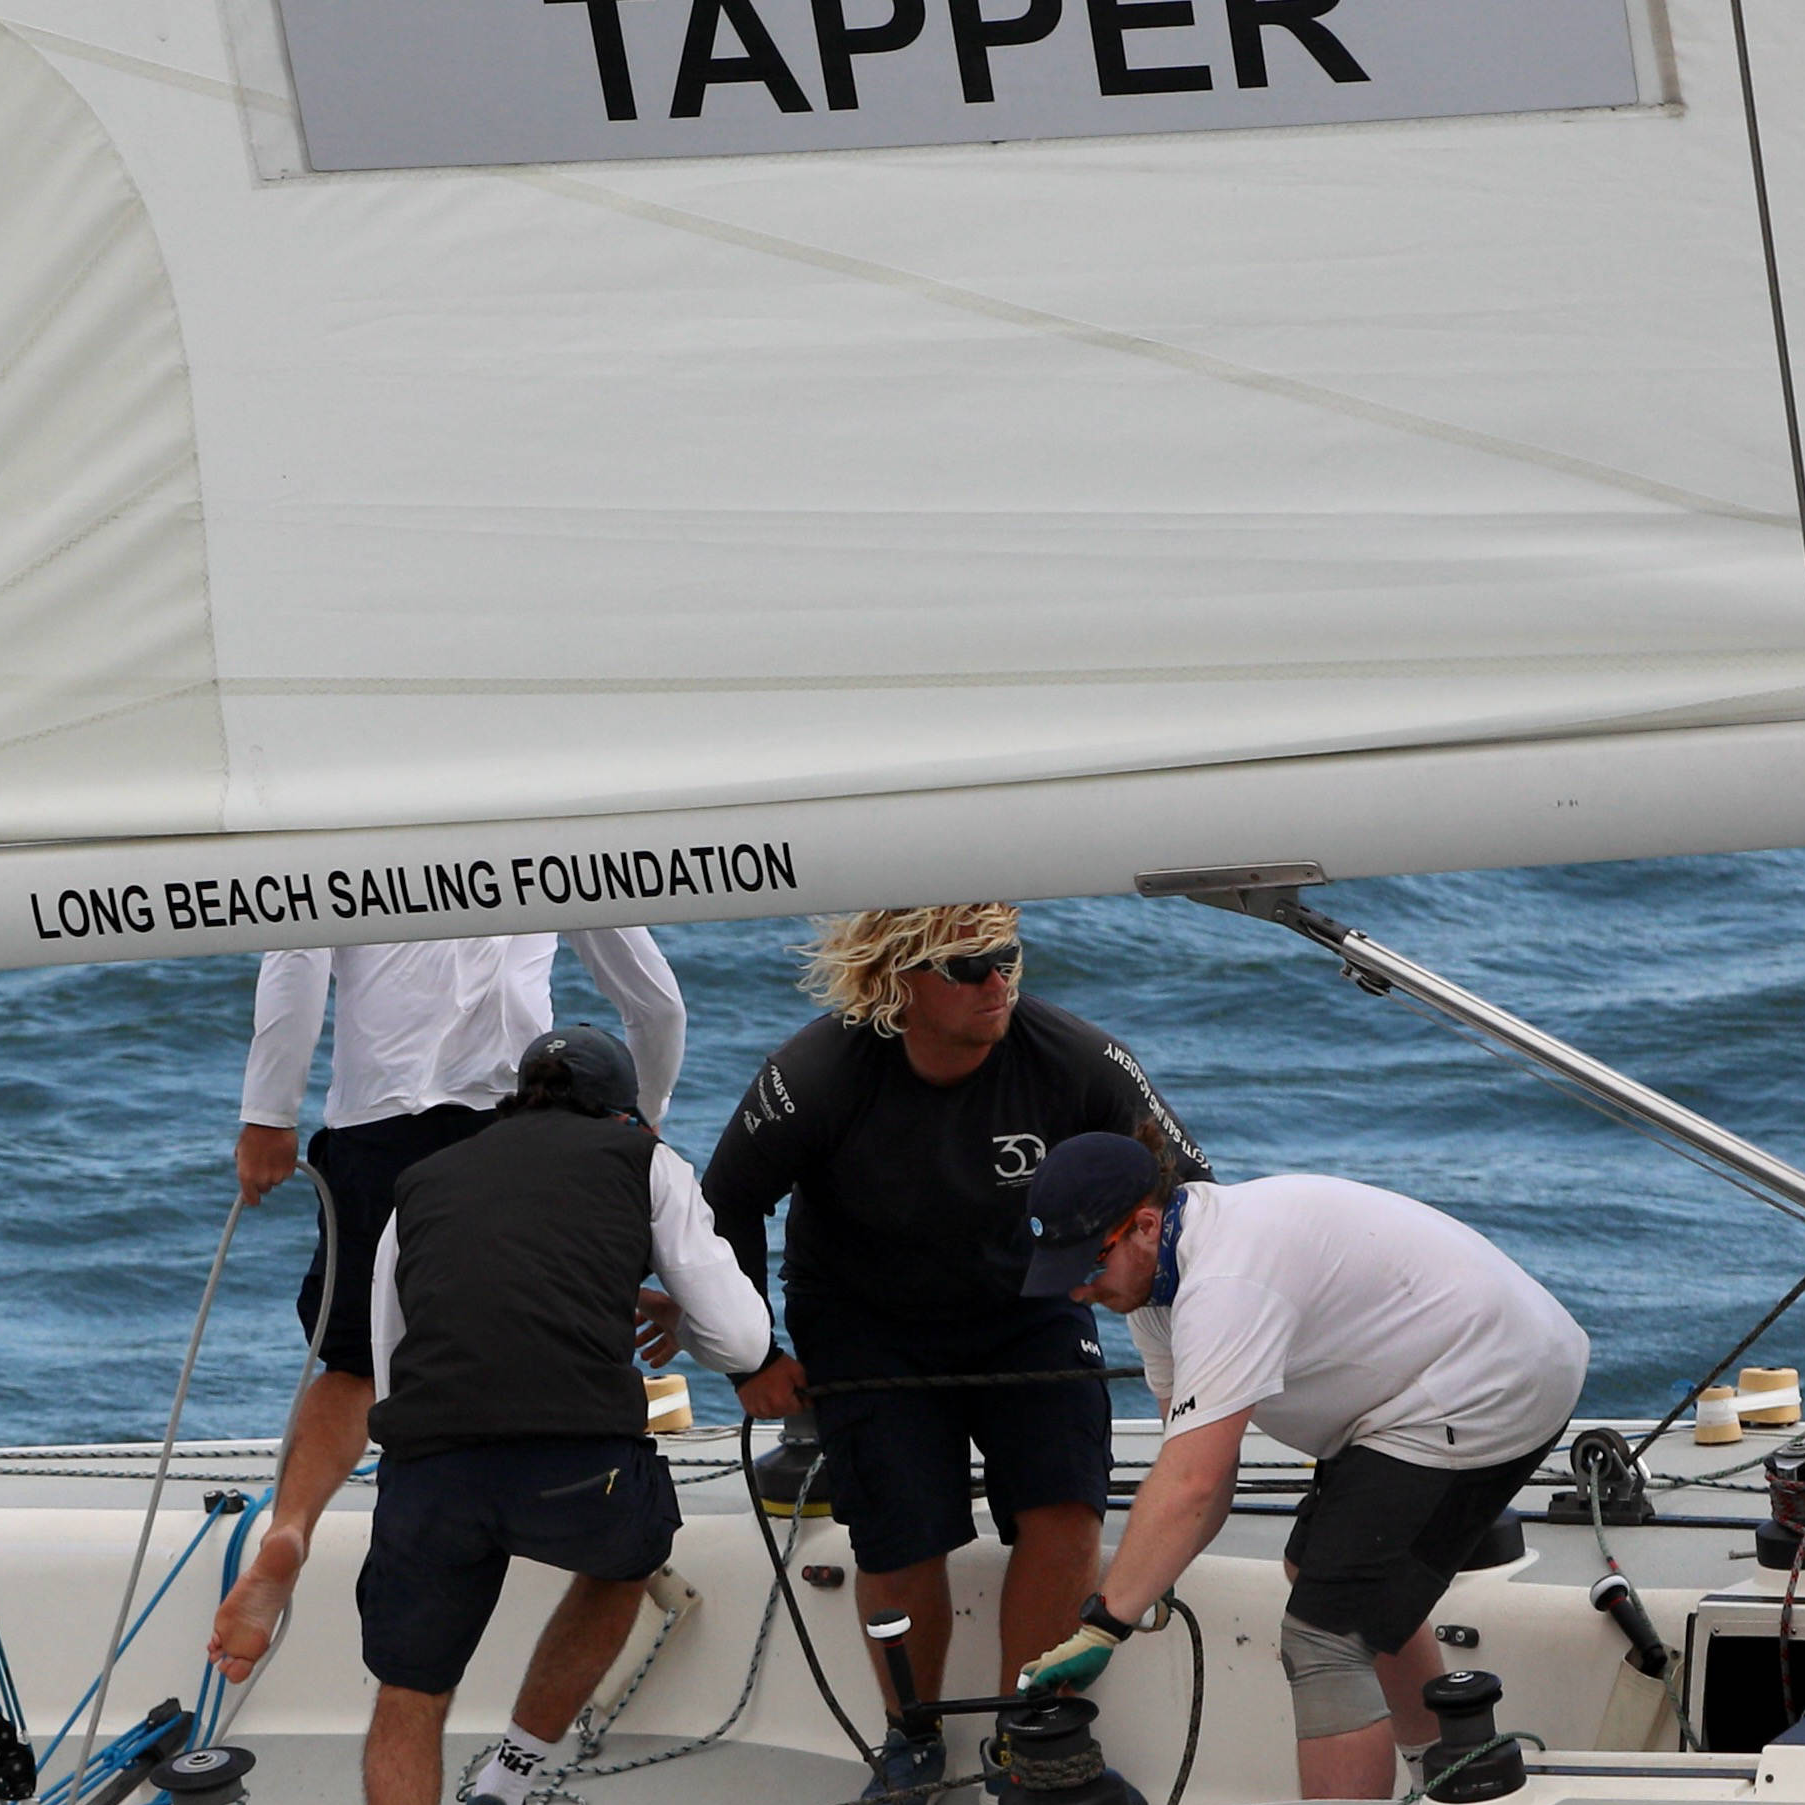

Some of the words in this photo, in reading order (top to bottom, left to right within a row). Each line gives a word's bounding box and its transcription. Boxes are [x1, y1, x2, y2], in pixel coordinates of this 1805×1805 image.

[543, 0, 1372, 121] TAPPER
[30, 885, 155, 939] LONG
[165, 874, 315, 930] BEACH
[330, 861, 502, 918] SAILING
[513, 842, 797, 905] FOUNDATION
[770, 1064, 795, 1114] MUSTO
[1104, 1042, 1152, 1099] ACADEMY
